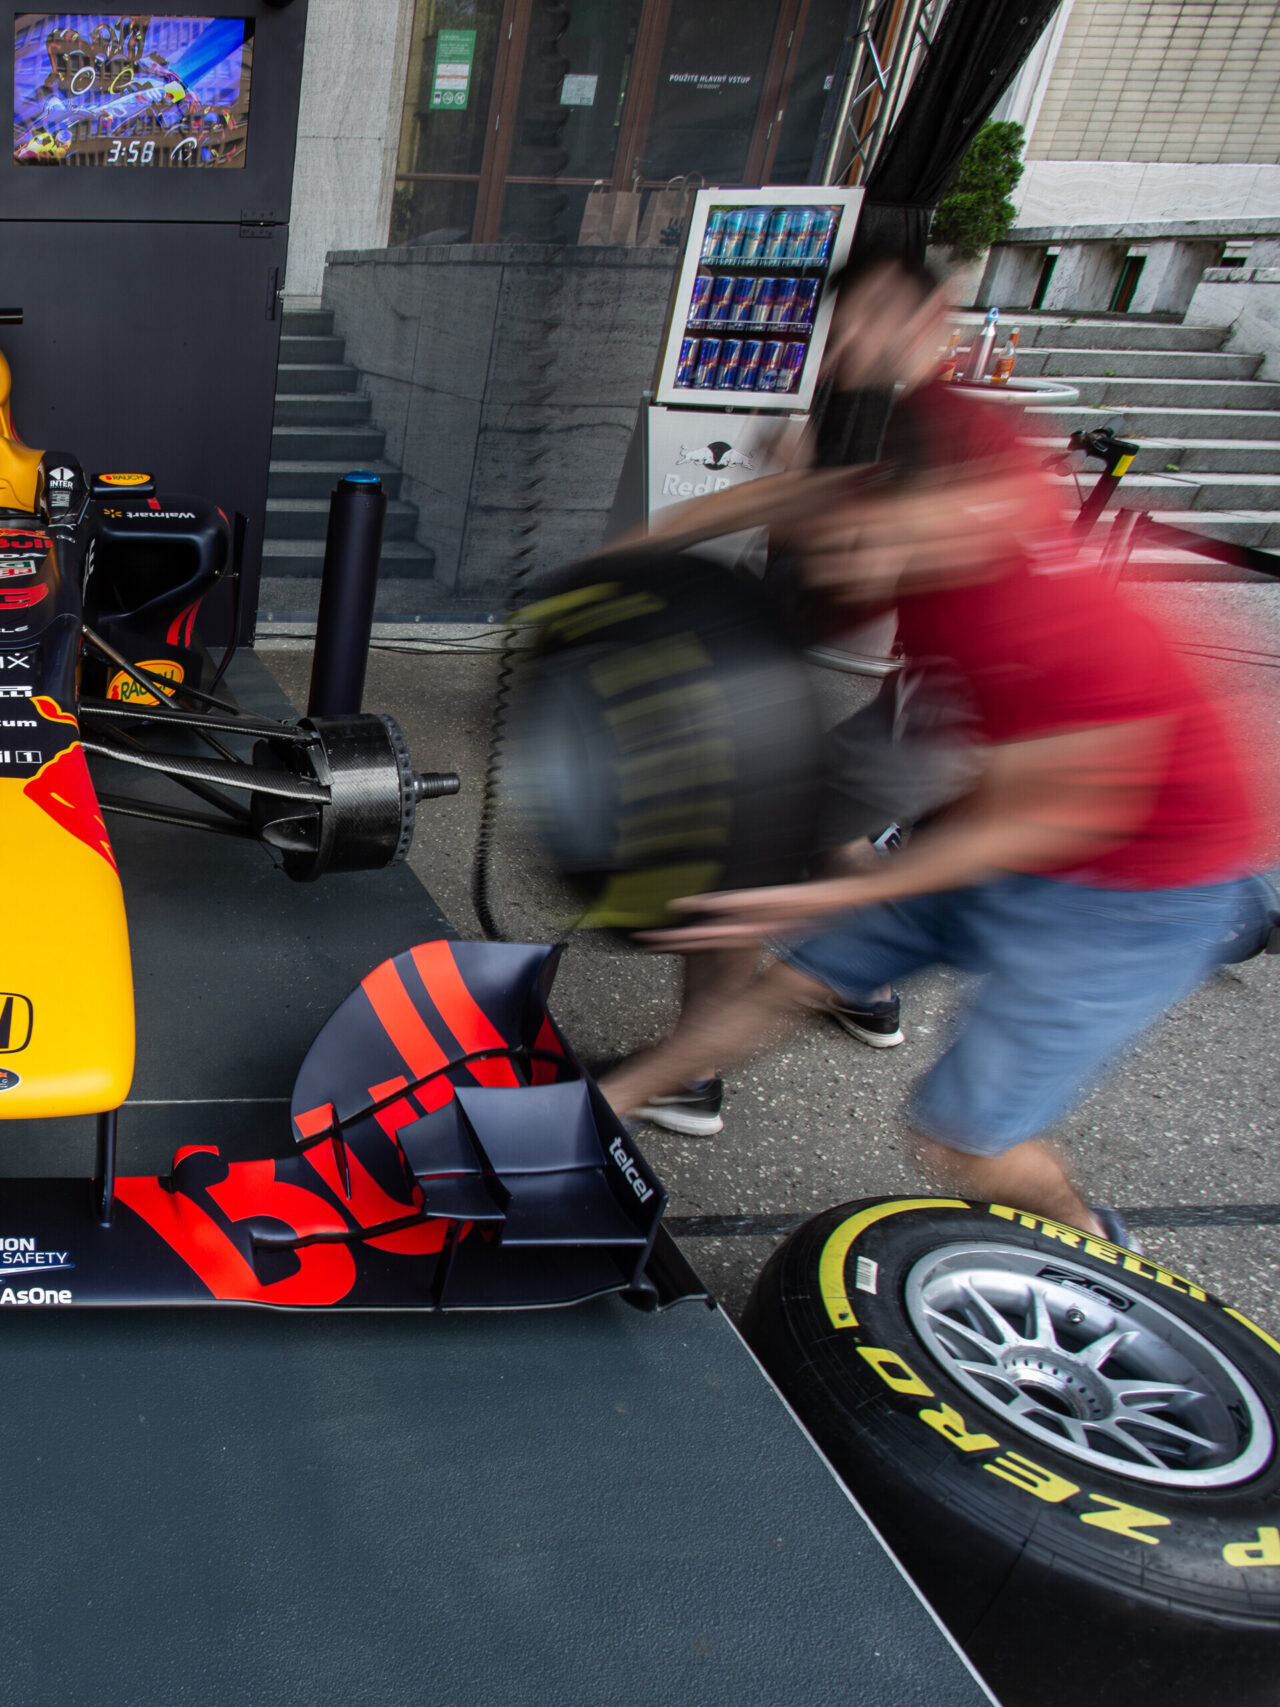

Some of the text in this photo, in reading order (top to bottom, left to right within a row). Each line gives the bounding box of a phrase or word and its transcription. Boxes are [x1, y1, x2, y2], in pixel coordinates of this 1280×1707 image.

[728, 76, 751, 84] VSTUP
[107, 140, 156, 163] 3:58
[50, 480, 73, 489] INTER
[126, 511, 196, 519] Walmart
[609, 1136, 654, 1203] telcel
[2, 1252, 68, 1264] SAFETY
[989, 1203, 1208, 1303] PIRELLI
[855, 1346, 1171, 1545] ZERO
